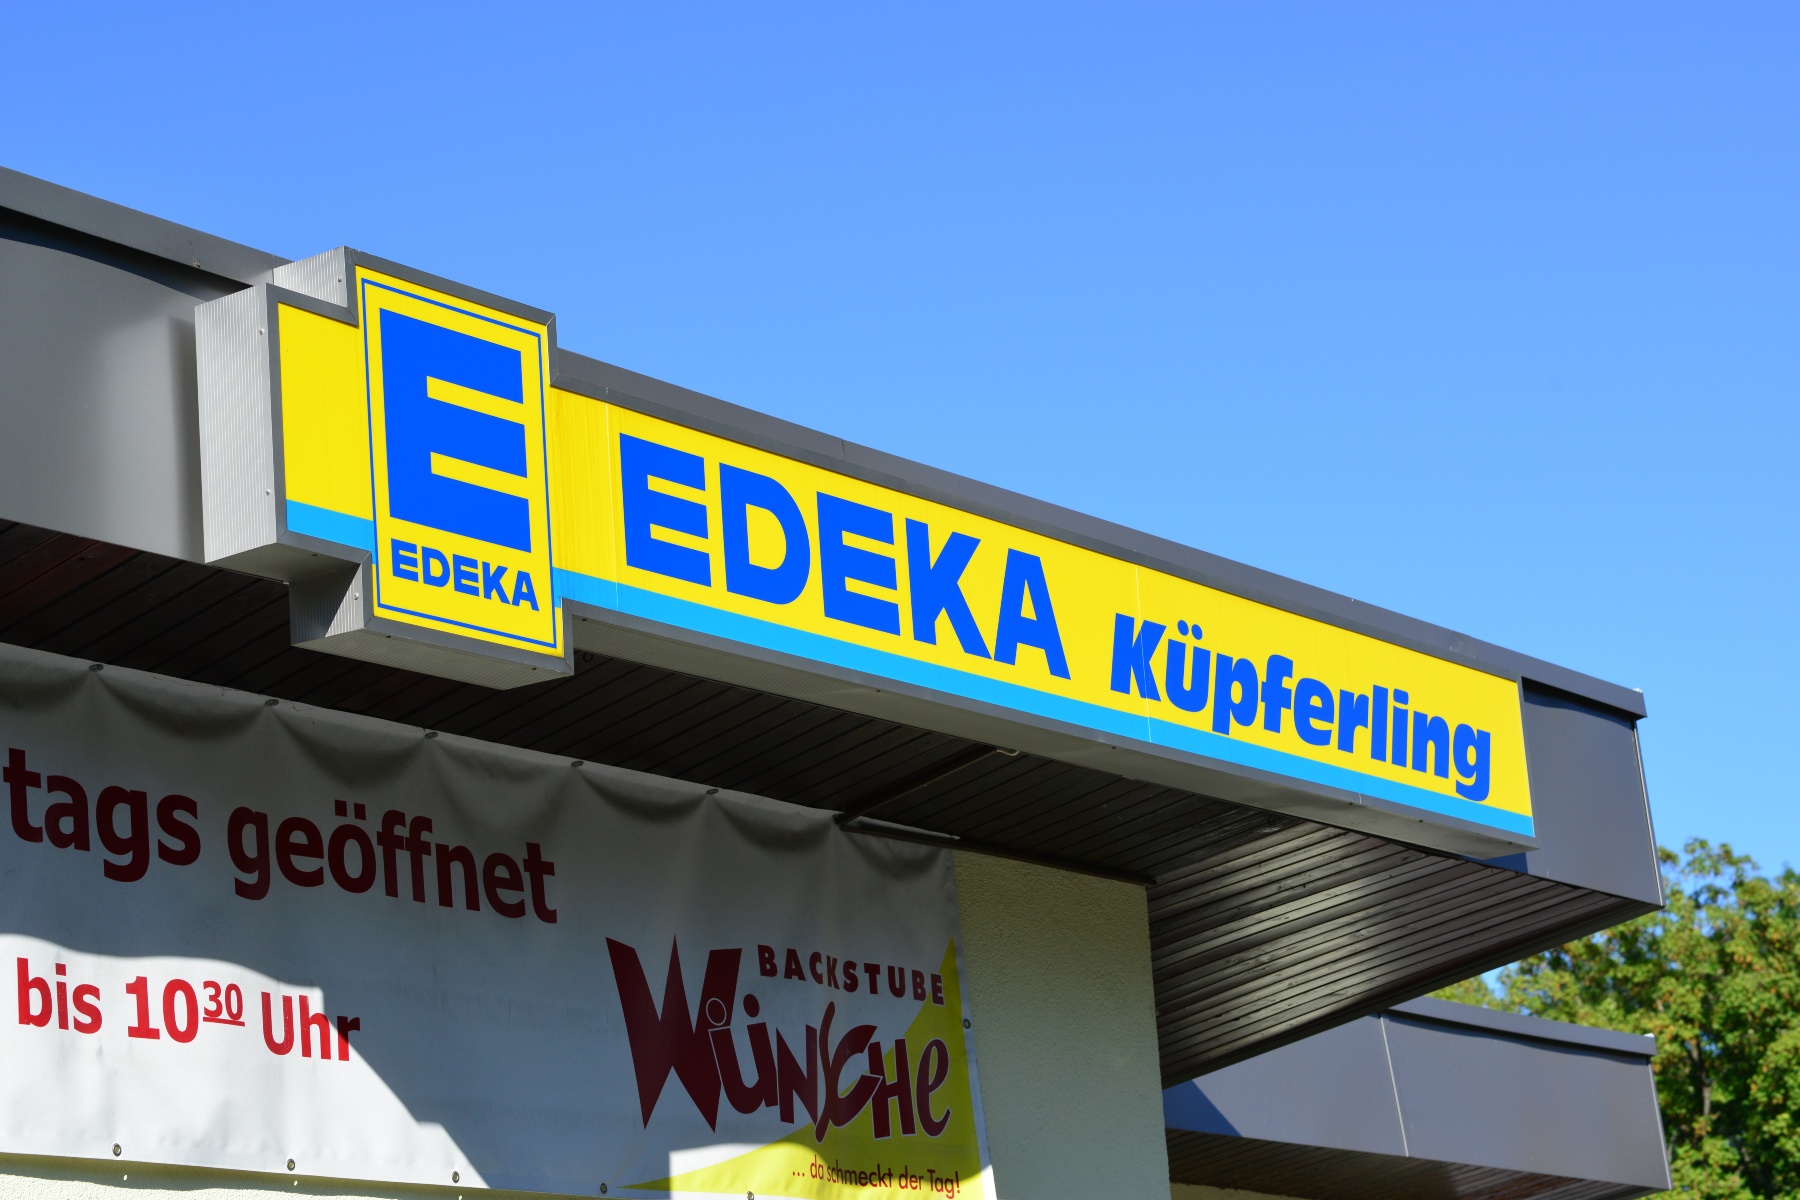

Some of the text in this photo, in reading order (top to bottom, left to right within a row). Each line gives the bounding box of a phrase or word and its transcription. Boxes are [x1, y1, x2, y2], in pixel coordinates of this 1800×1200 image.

[379, 307, 532, 554] E
[391, 538, 540, 612] EDEKA
[619, 432, 1491, 802] EDEKA Küpferling
[3, 747, 558, 924] tags geöffnet
[16, 957, 102, 1035] bis
[261, 991, 361, 1062] Uhr
[757, 944, 945, 1006] BACKSTUBE
[809, 1153, 825, 1181] da
[826, 1158, 893, 1188] schmeckt
[898, 1164, 924, 1191] der
[927, 1168, 961, 1200] Tag!
